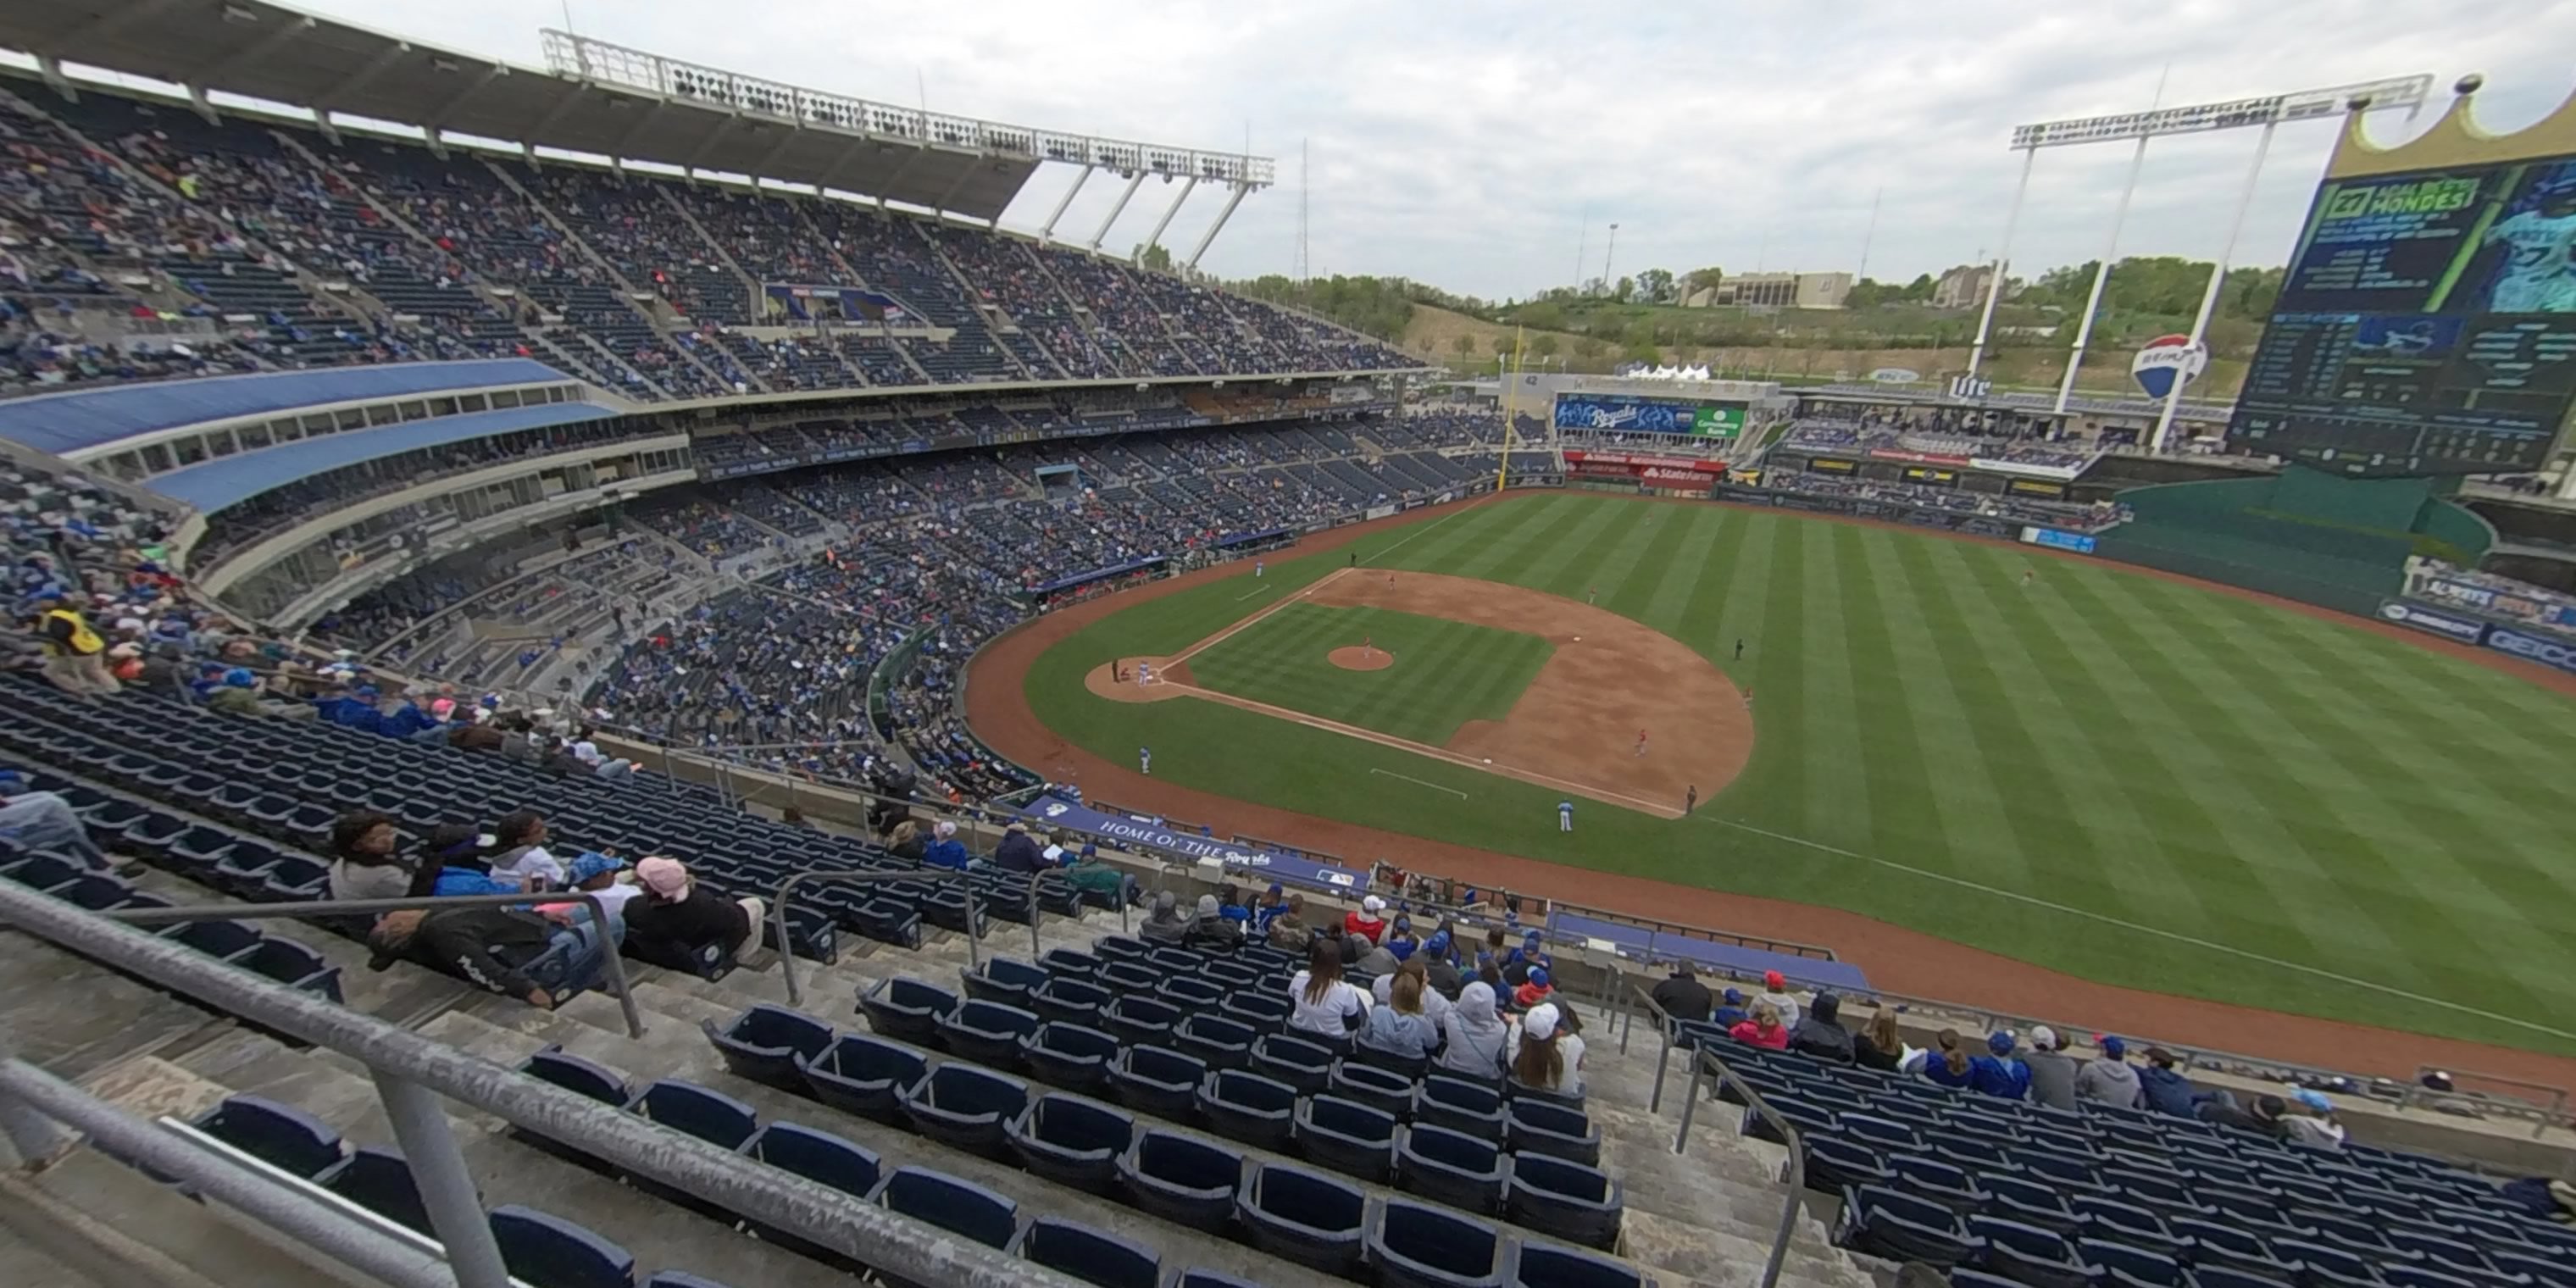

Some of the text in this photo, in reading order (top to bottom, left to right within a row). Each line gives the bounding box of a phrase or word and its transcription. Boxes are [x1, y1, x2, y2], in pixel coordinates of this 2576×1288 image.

[2334, 193, 2367, 213] 27
[1525, 375, 1538, 386] 42
[1591, 404, 1637, 428] Royals
[1659, 468, 1714, 481] State Farm
[1101, 820, 1154, 842] HOME
[1186, 841, 1222, 857] THE
